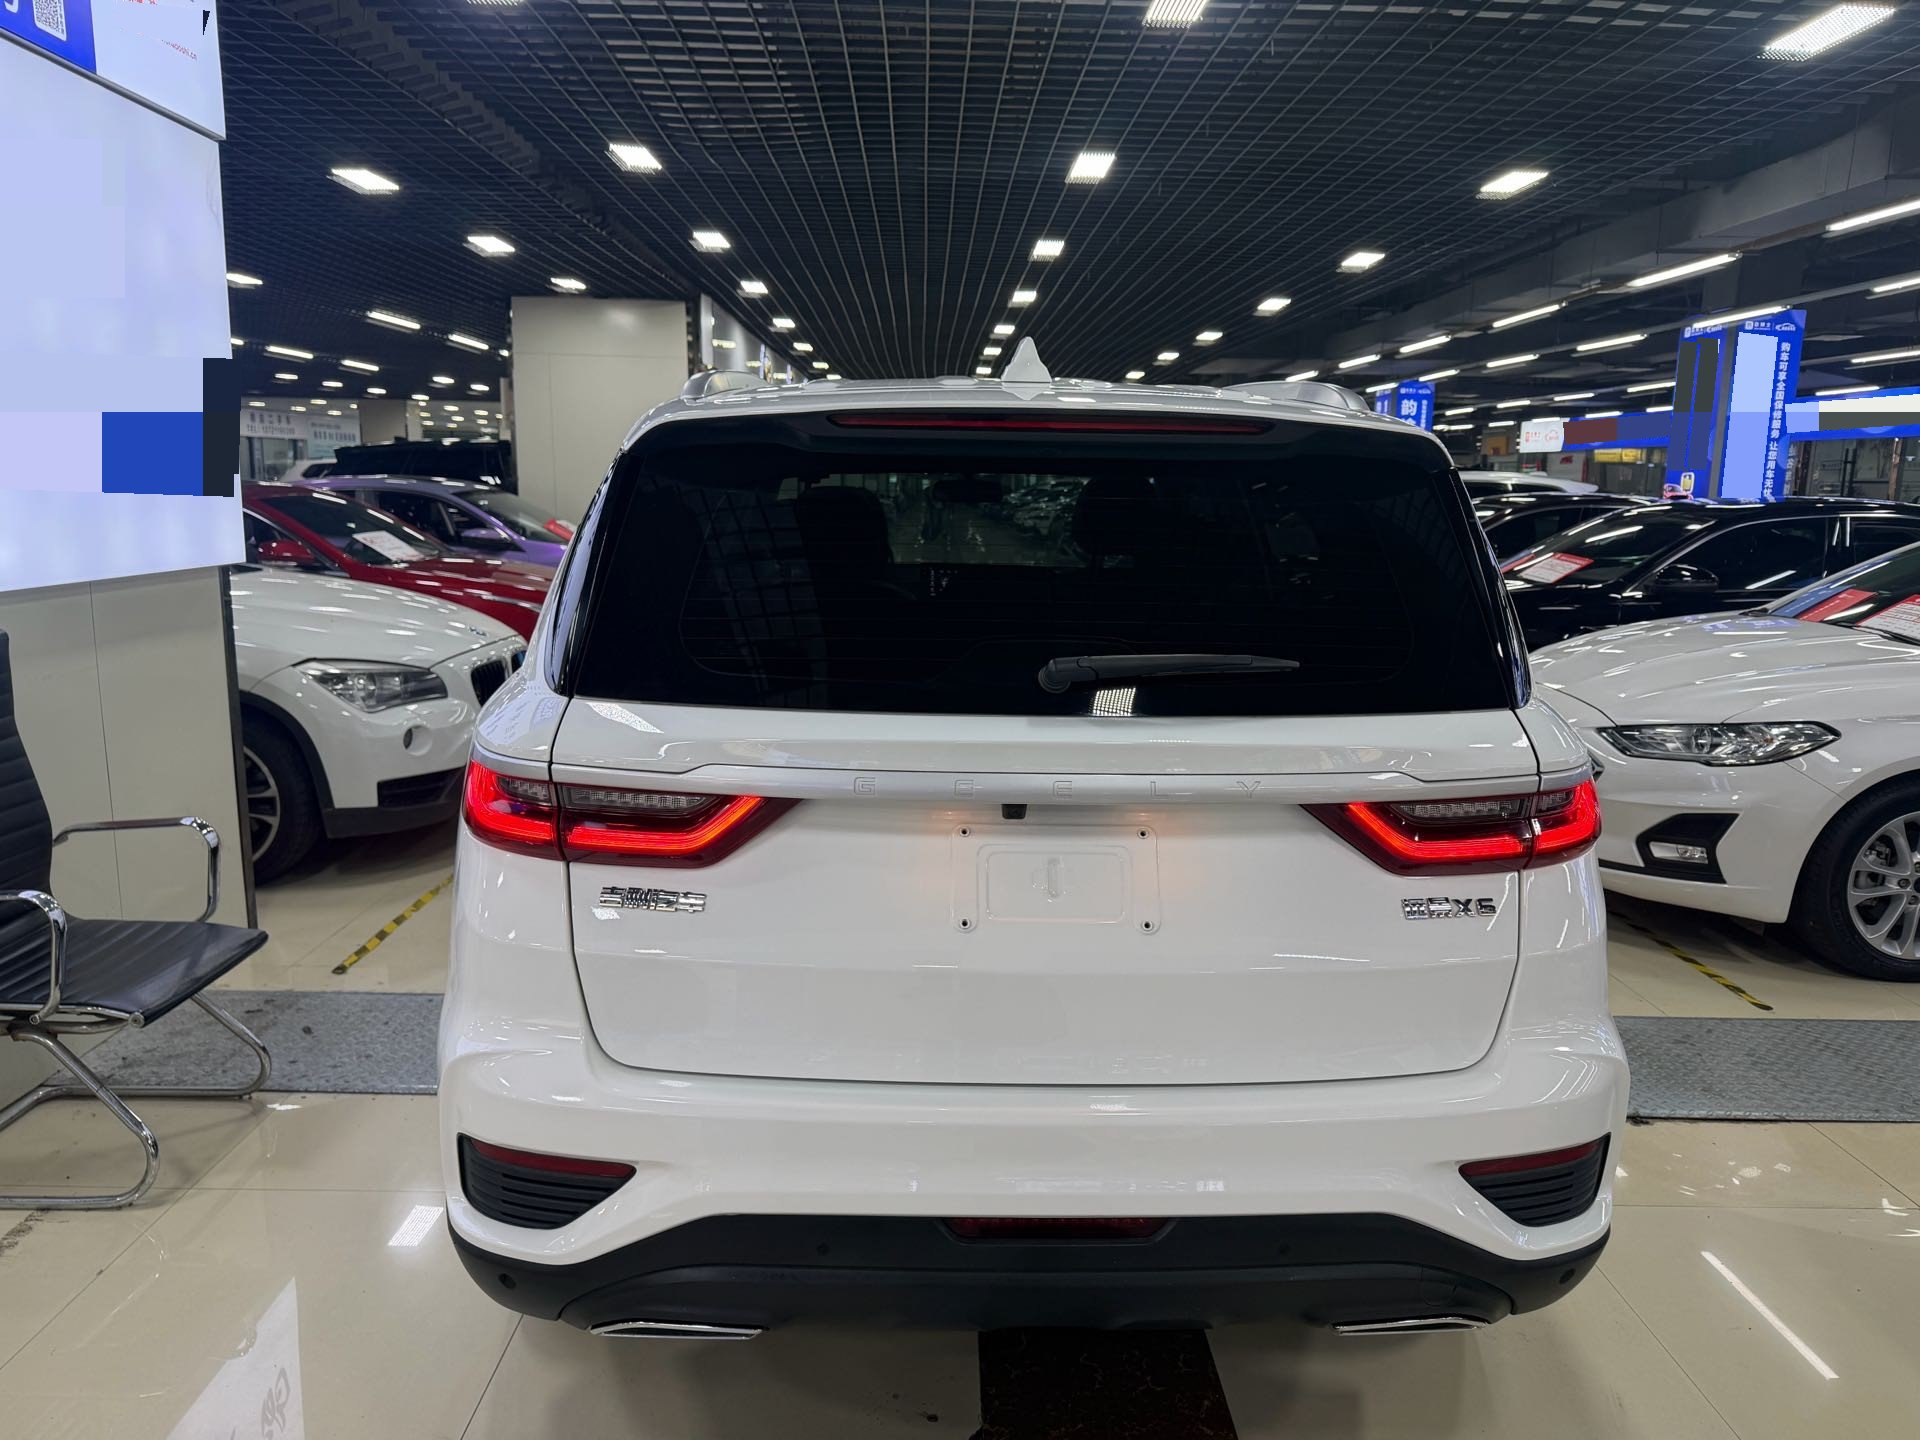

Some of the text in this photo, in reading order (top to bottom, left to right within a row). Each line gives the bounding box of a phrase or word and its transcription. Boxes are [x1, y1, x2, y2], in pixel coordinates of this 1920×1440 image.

[1769, 341, 1791, 439] 购车可享全国保修服务
[853, 776, 1261, 798] GEELY
[599, 886, 707, 913] 吉利汽车
